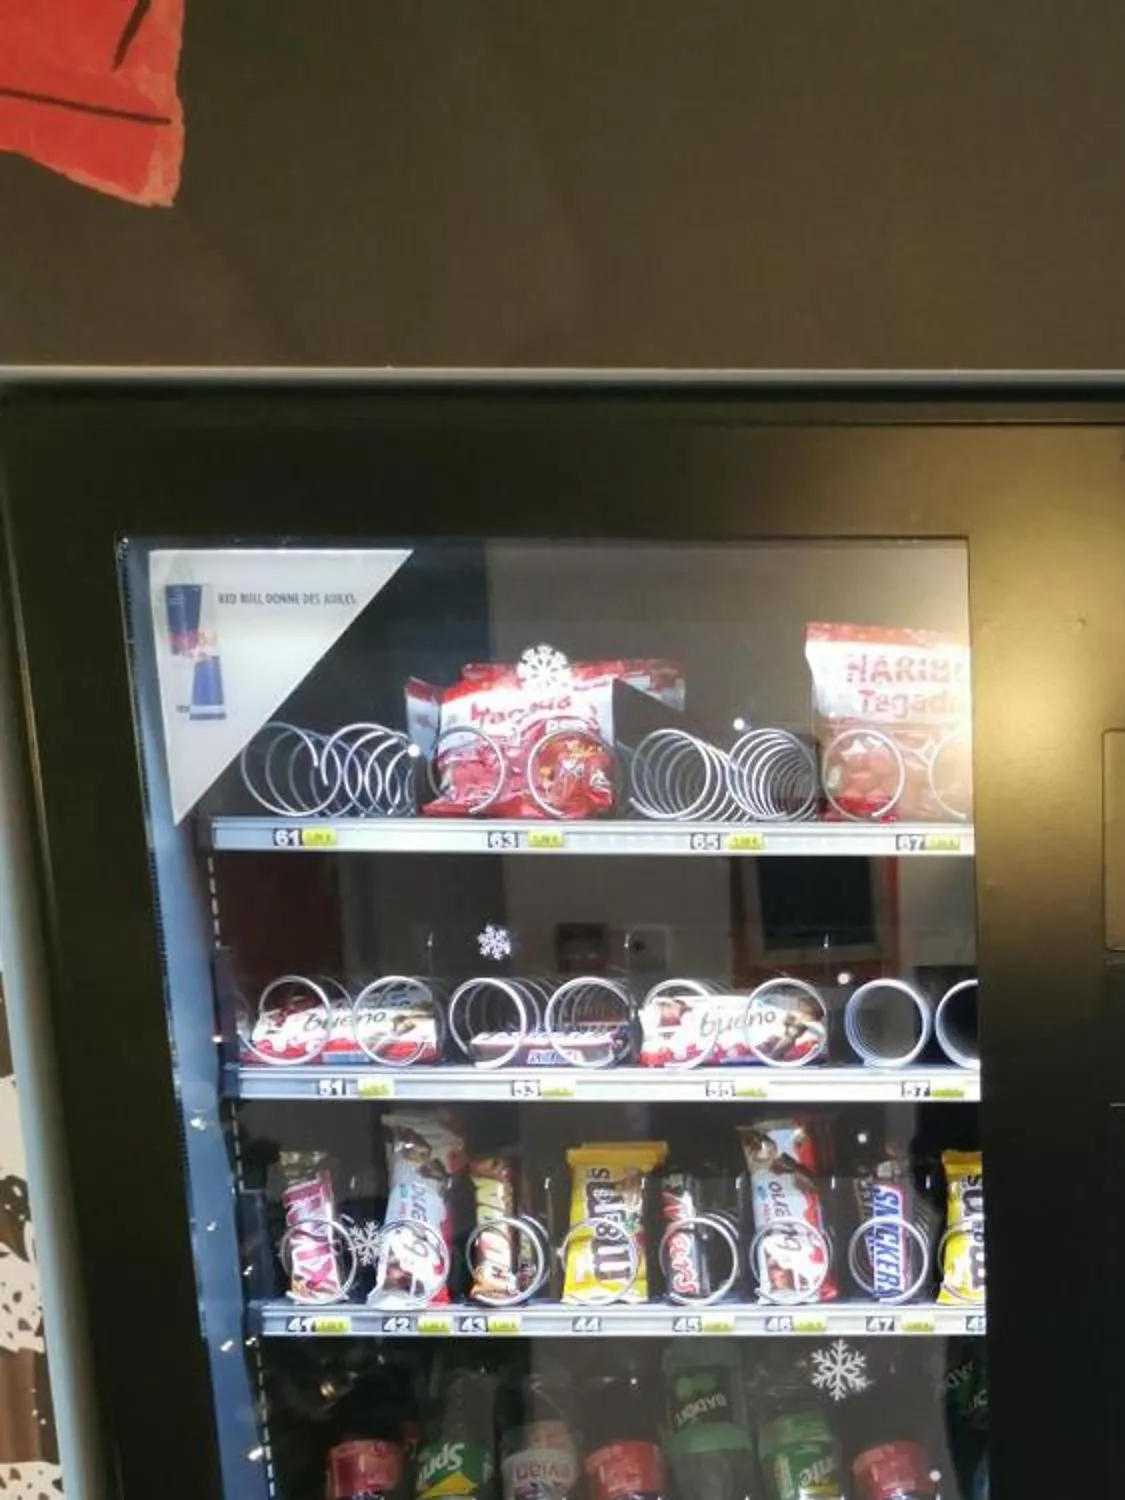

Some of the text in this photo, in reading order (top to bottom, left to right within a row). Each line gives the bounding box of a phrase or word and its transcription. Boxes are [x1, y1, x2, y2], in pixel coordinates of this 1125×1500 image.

[273, 828, 301, 848] 61
[487, 831, 518, 848] 63
[690, 832, 721, 849] 65
[872, 1184, 902, 1298] SNICKERS
[381, 1317, 411, 1333] 42
[460, 1316, 488, 1332] 43
[672, 1316, 702, 1332] 45
[866, 1315, 895, 1331] 47
